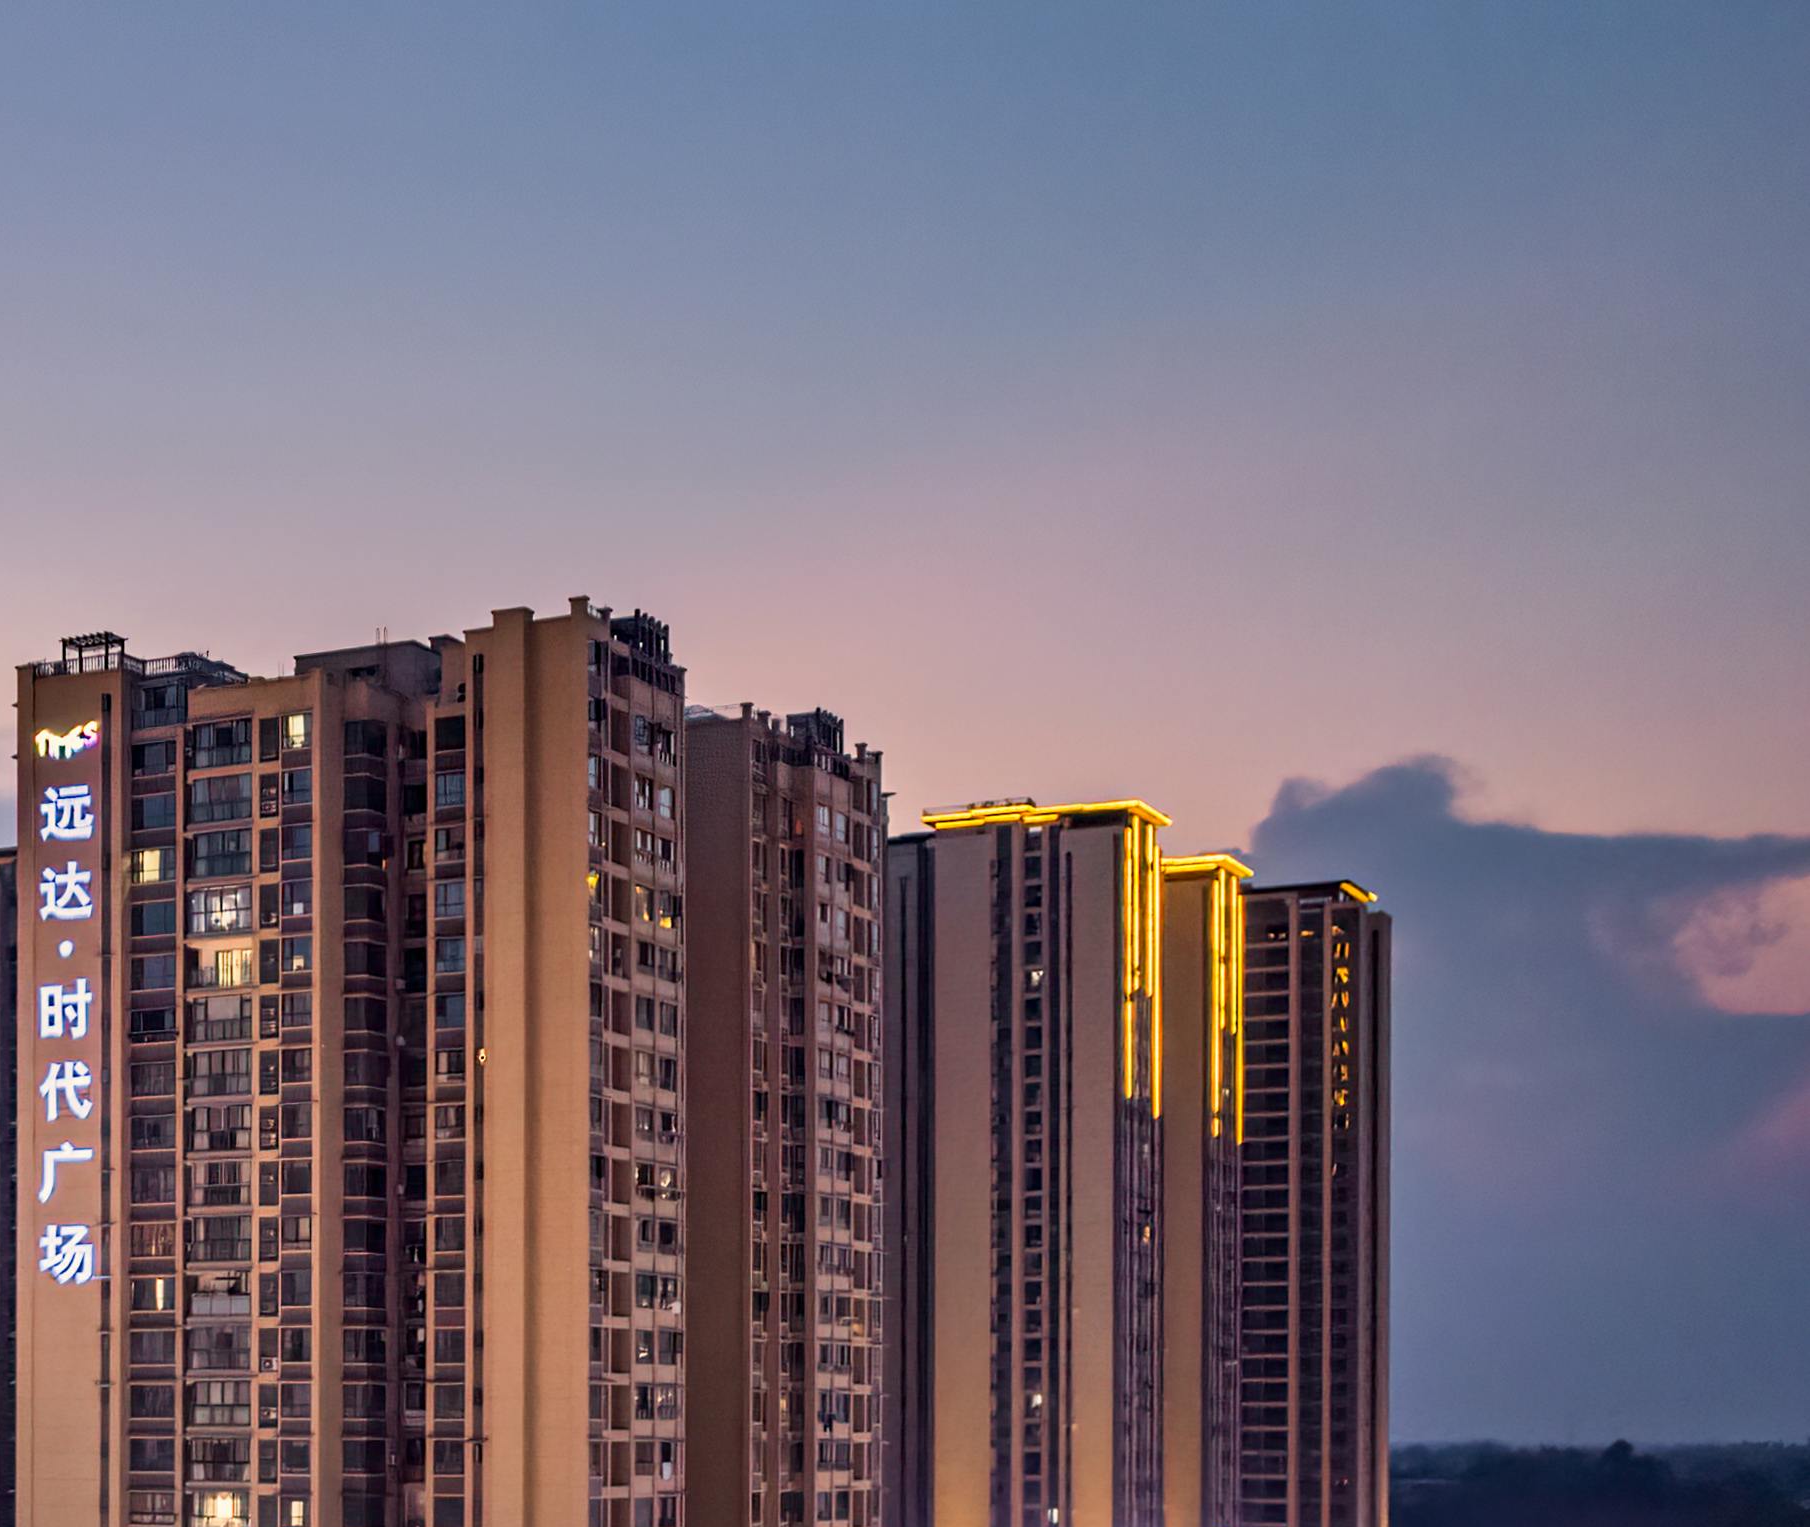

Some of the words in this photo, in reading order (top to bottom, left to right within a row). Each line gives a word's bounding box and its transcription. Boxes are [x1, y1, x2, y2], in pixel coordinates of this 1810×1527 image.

[39, 783, 95, 1285] 远达·时代广场
